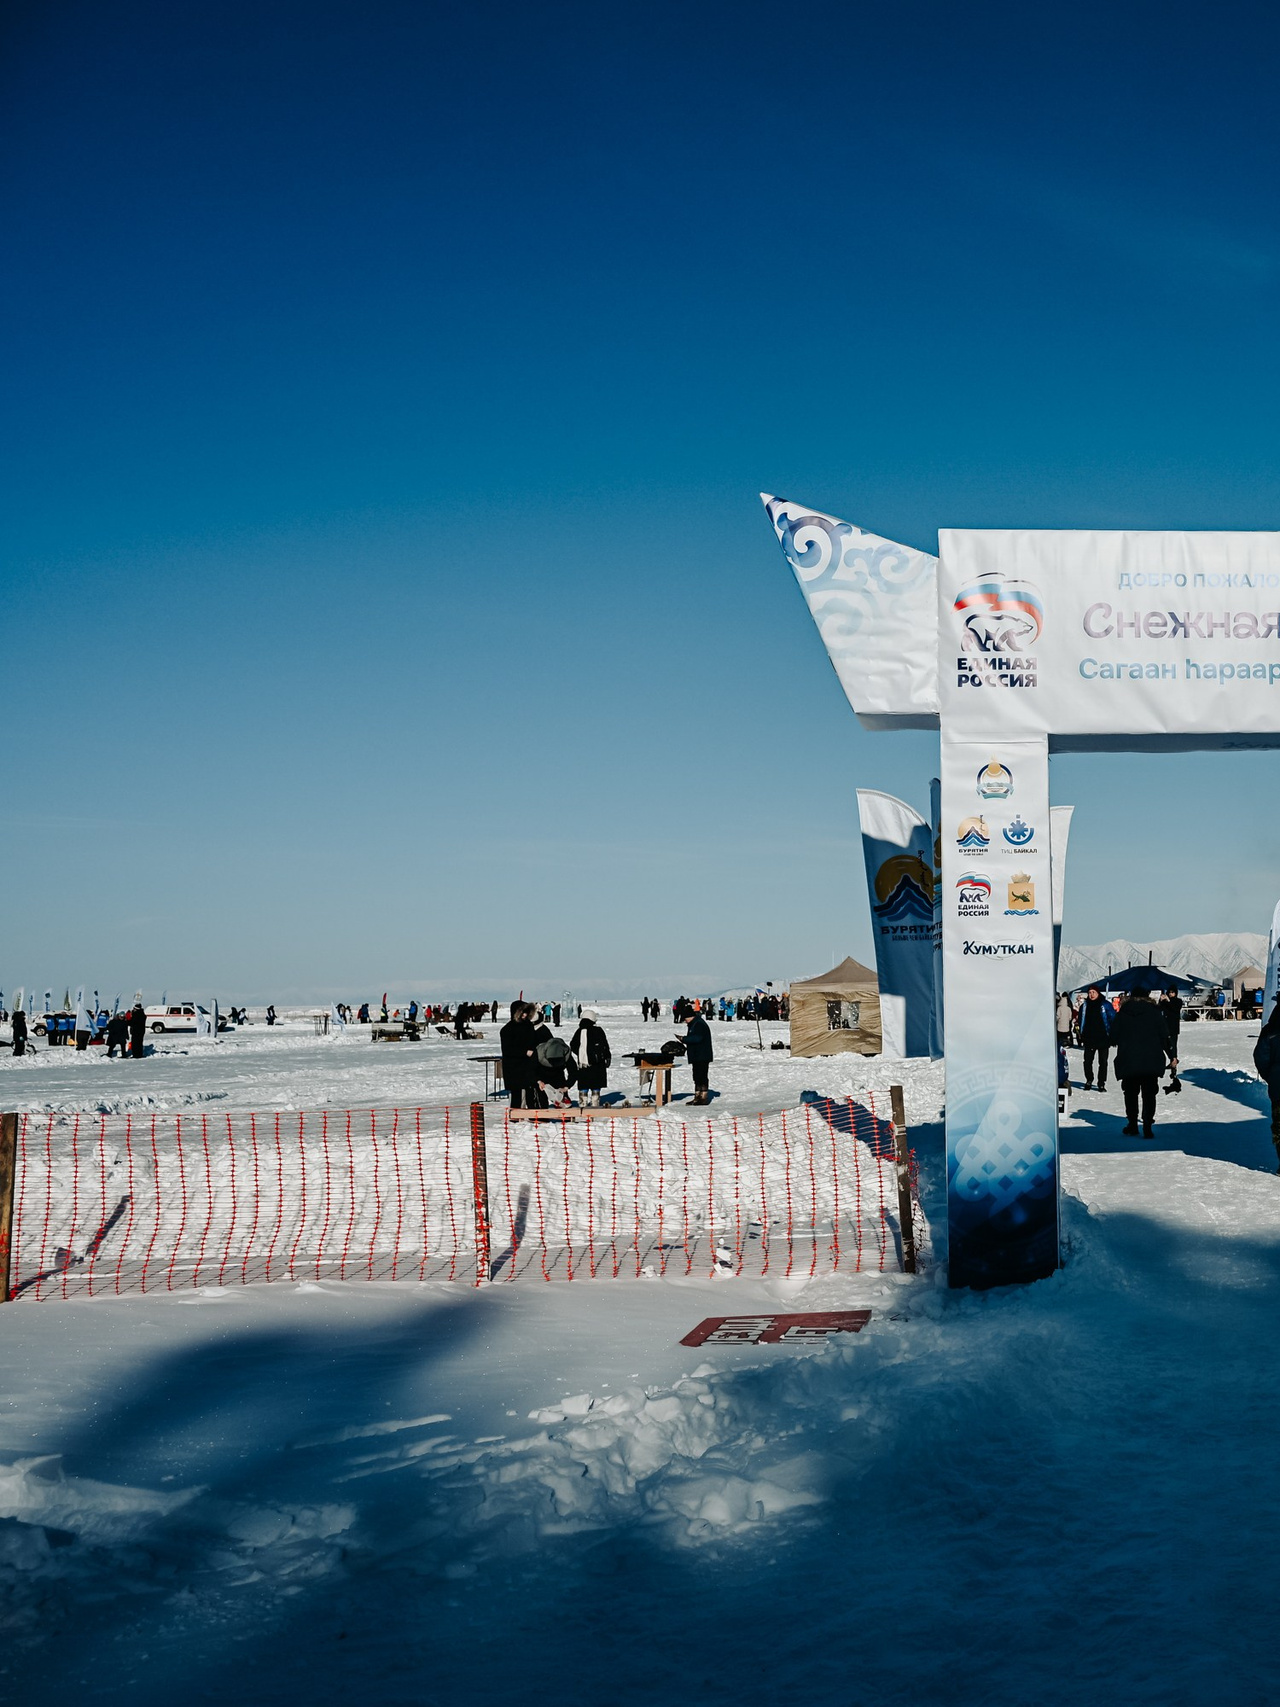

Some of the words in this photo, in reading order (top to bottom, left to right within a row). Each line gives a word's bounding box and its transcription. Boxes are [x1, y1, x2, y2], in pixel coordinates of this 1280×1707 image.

[1119, 573, 1187, 590] ДОБРО
[957, 657, 1038, 672] ЕДИНАЯ
[1079, 658, 1176, 680] Сагаан
[957, 673, 1038, 688] РОССИЯ
[881, 924, 933, 935] БУРЯТИ
